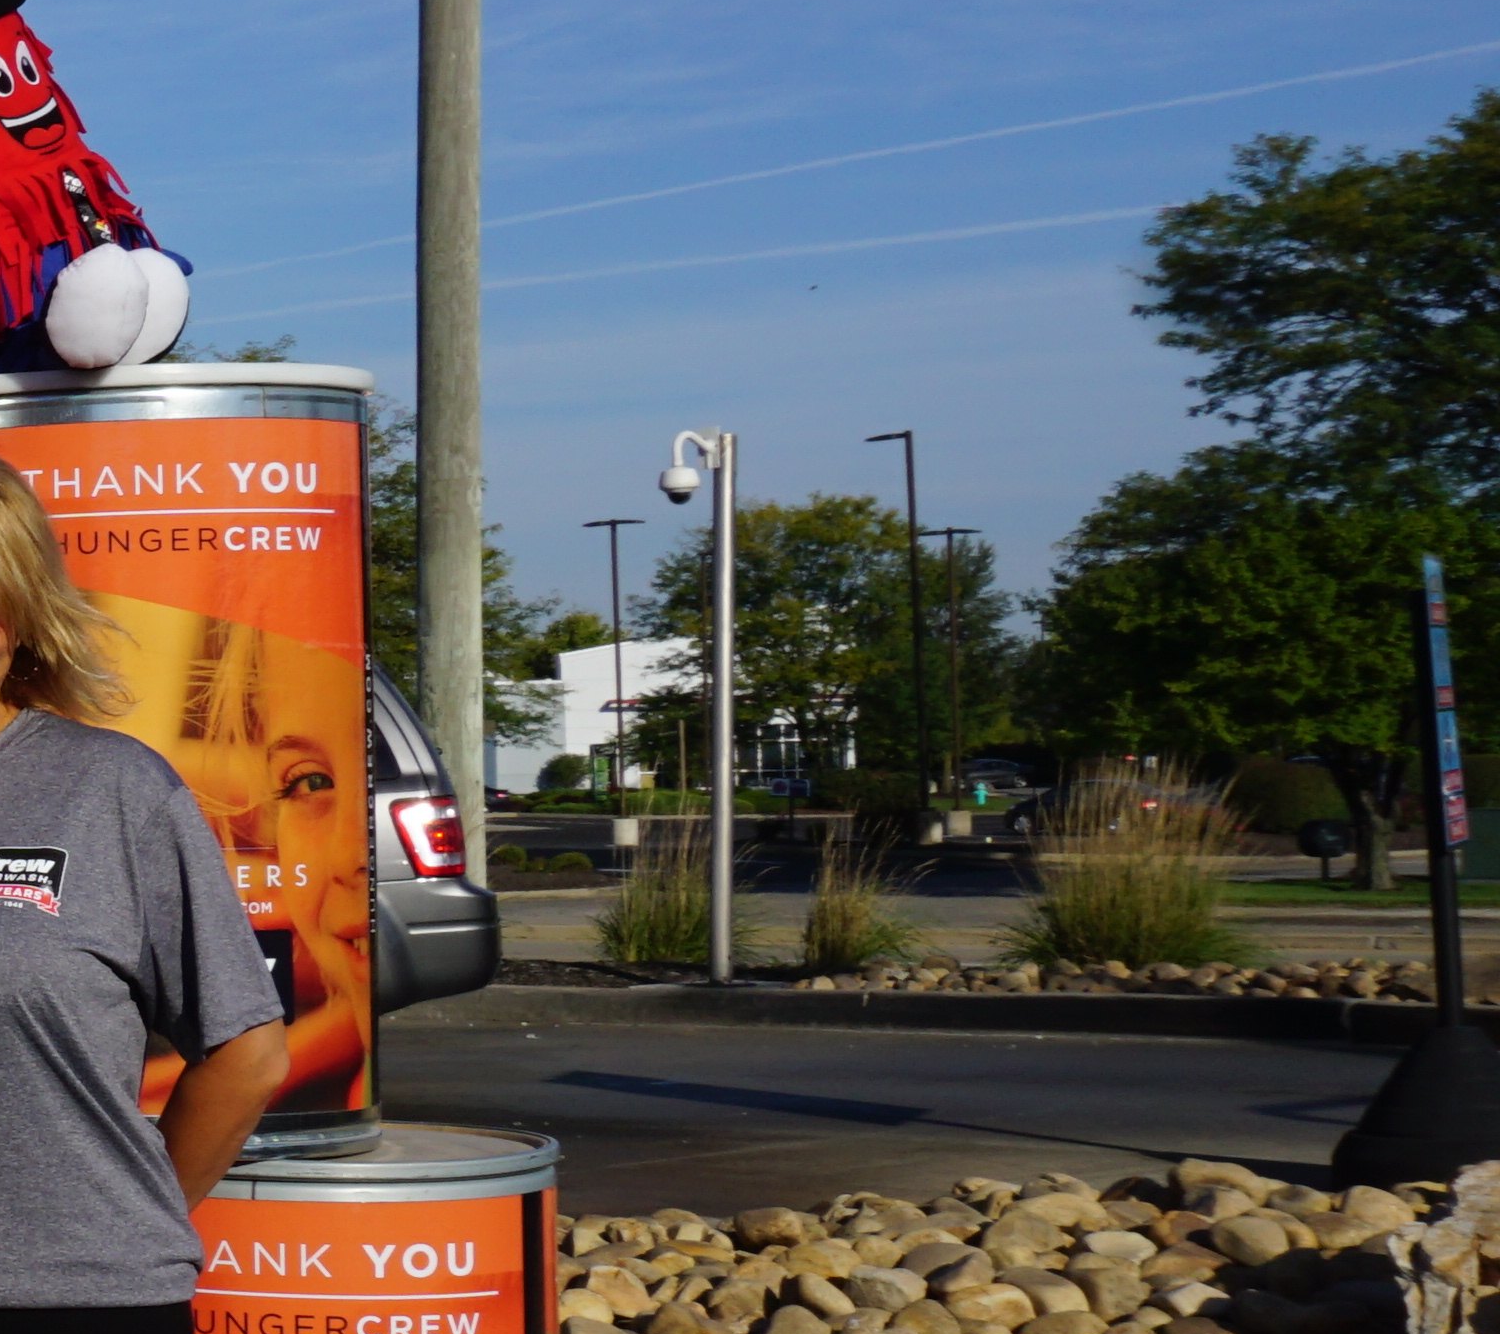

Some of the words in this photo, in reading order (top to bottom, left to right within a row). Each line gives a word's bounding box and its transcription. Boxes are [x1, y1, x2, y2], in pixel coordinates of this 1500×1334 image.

[229, 462, 317, 493] YOU
[208, 1239, 333, 1278] ANK
[363, 1241, 476, 1279] YOU
